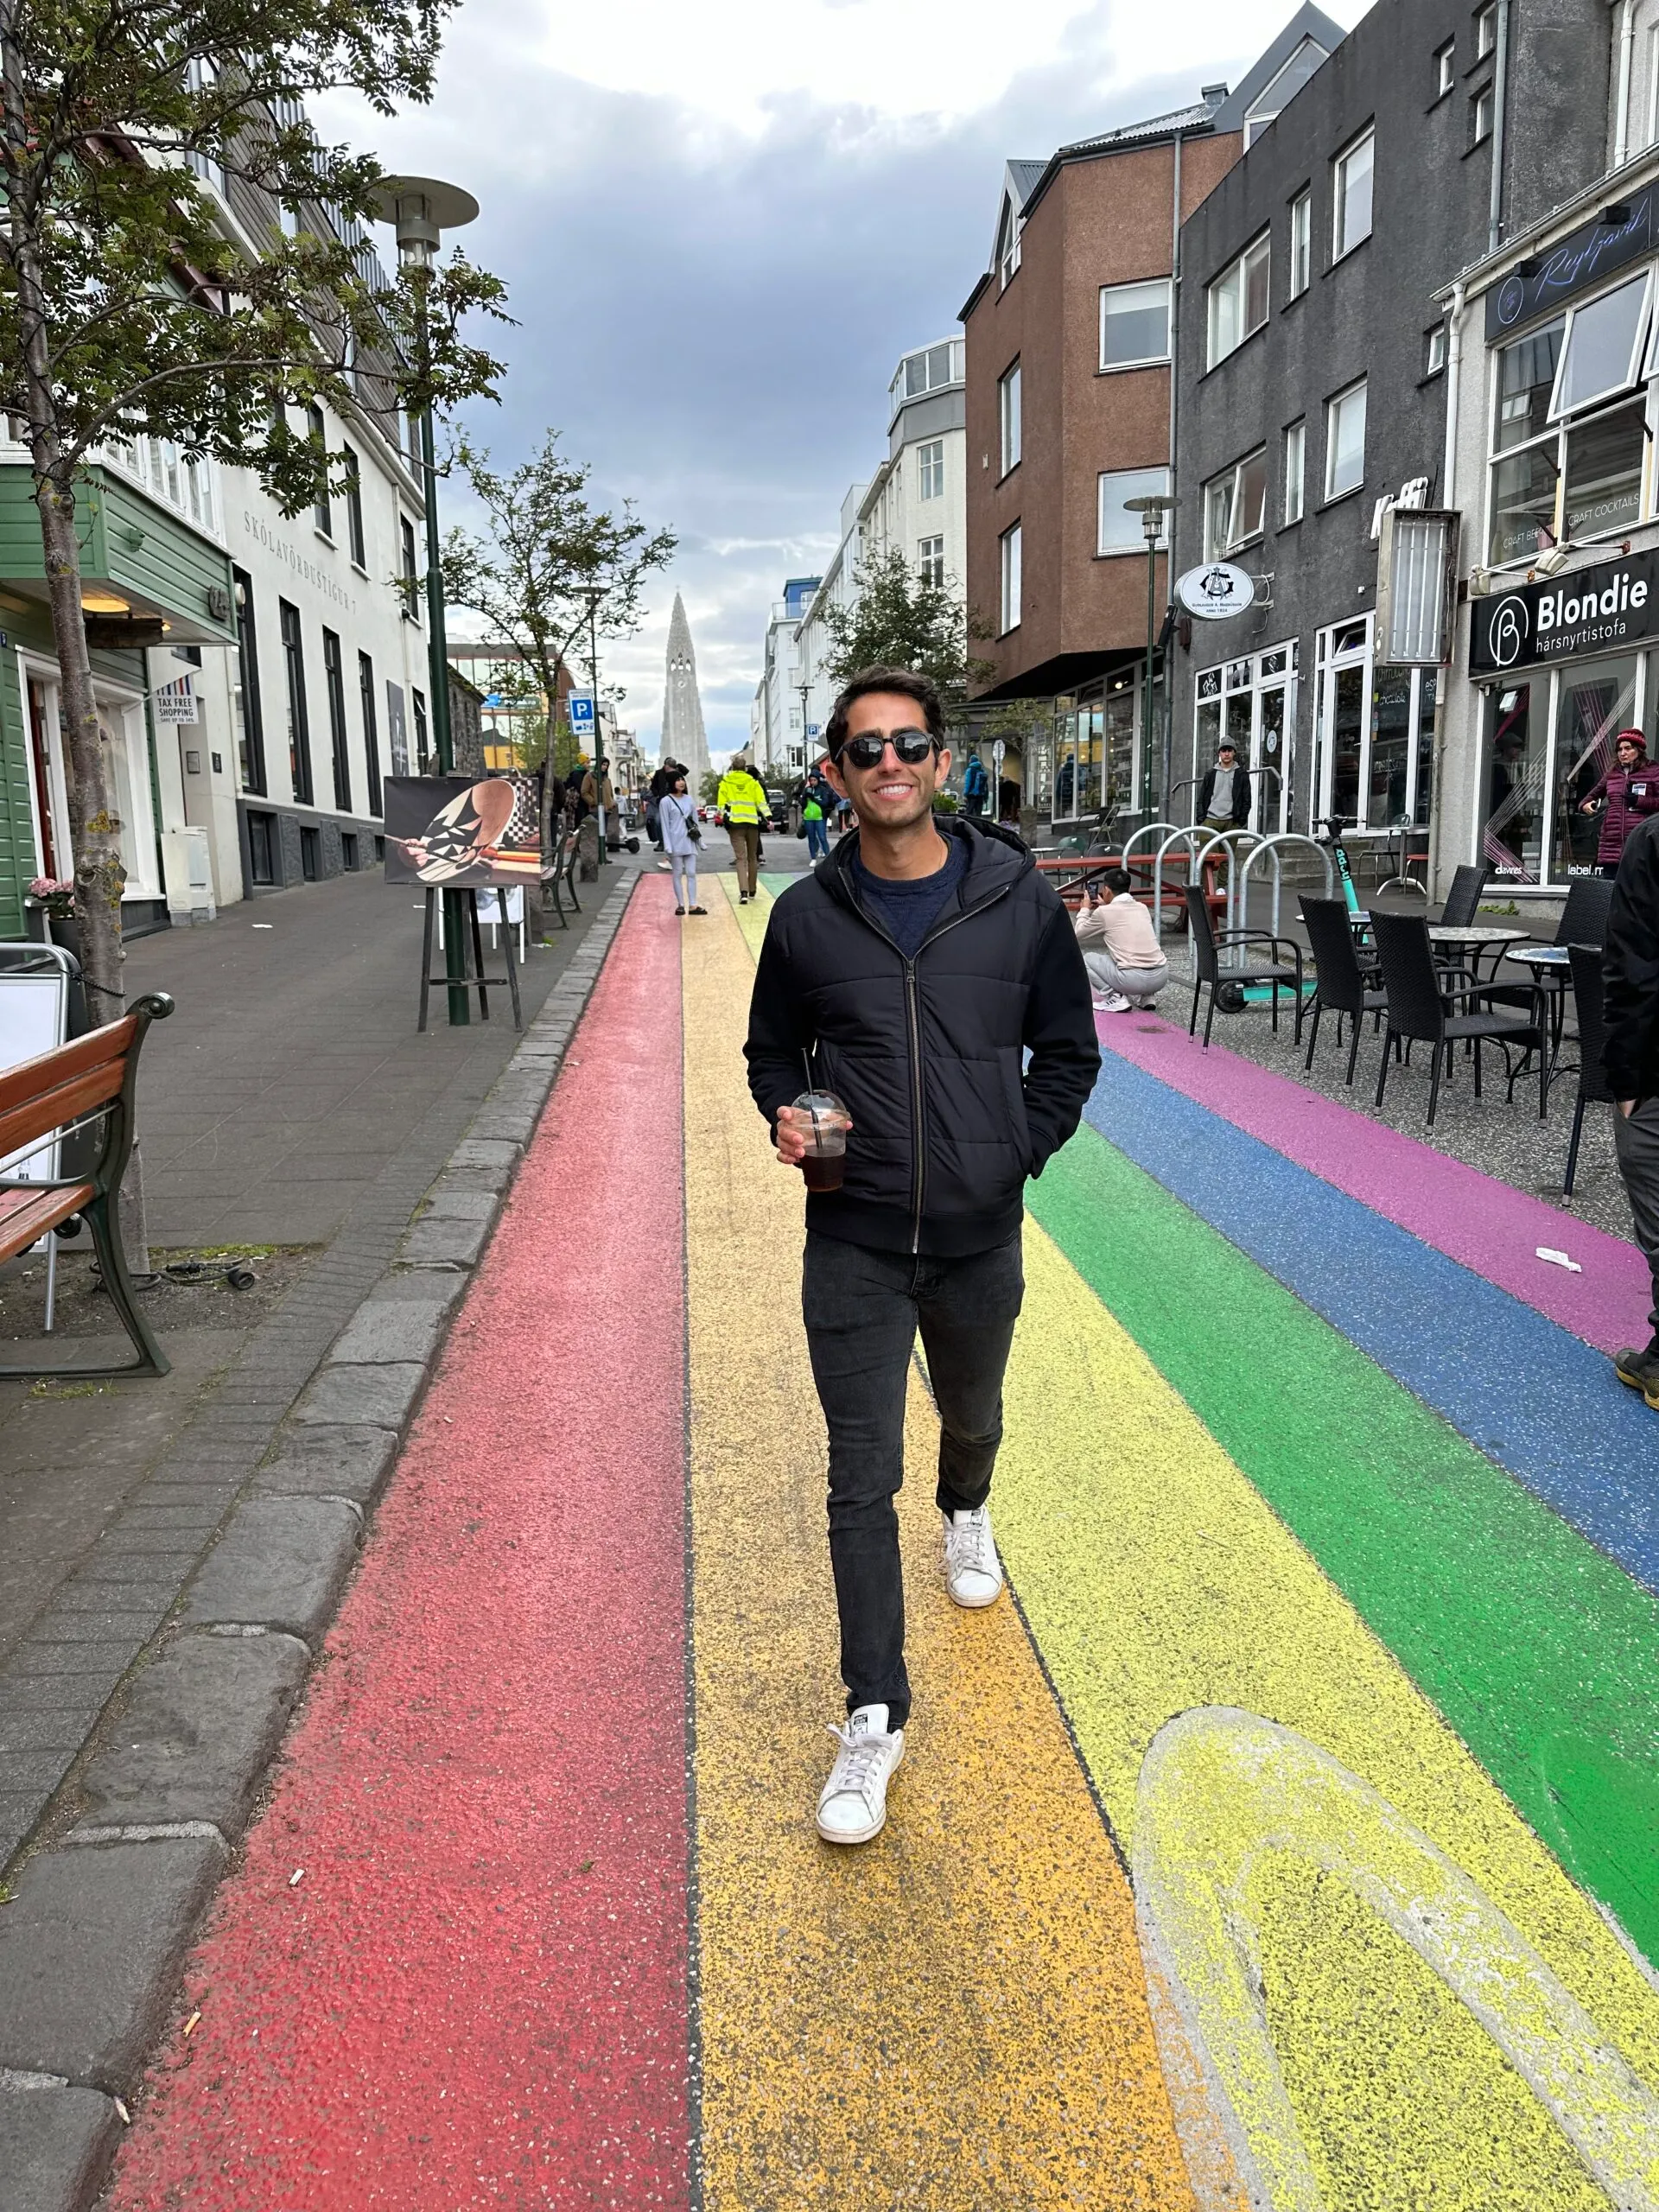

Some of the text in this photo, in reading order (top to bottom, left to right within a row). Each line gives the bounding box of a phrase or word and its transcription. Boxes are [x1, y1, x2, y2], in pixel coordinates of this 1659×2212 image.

[1568, 493, 1639, 526] CRAFT COCKTAILS
[1503, 532, 1525, 549] CRAFT
[1537, 573, 1648, 632] Blondie
[1536, 618, 1626, 653] hársnyrtistofa
[157, 698, 193, 707] TAX FREE
[576, 702, 588, 717] P
[159, 708, 194, 716] SHOPPING
